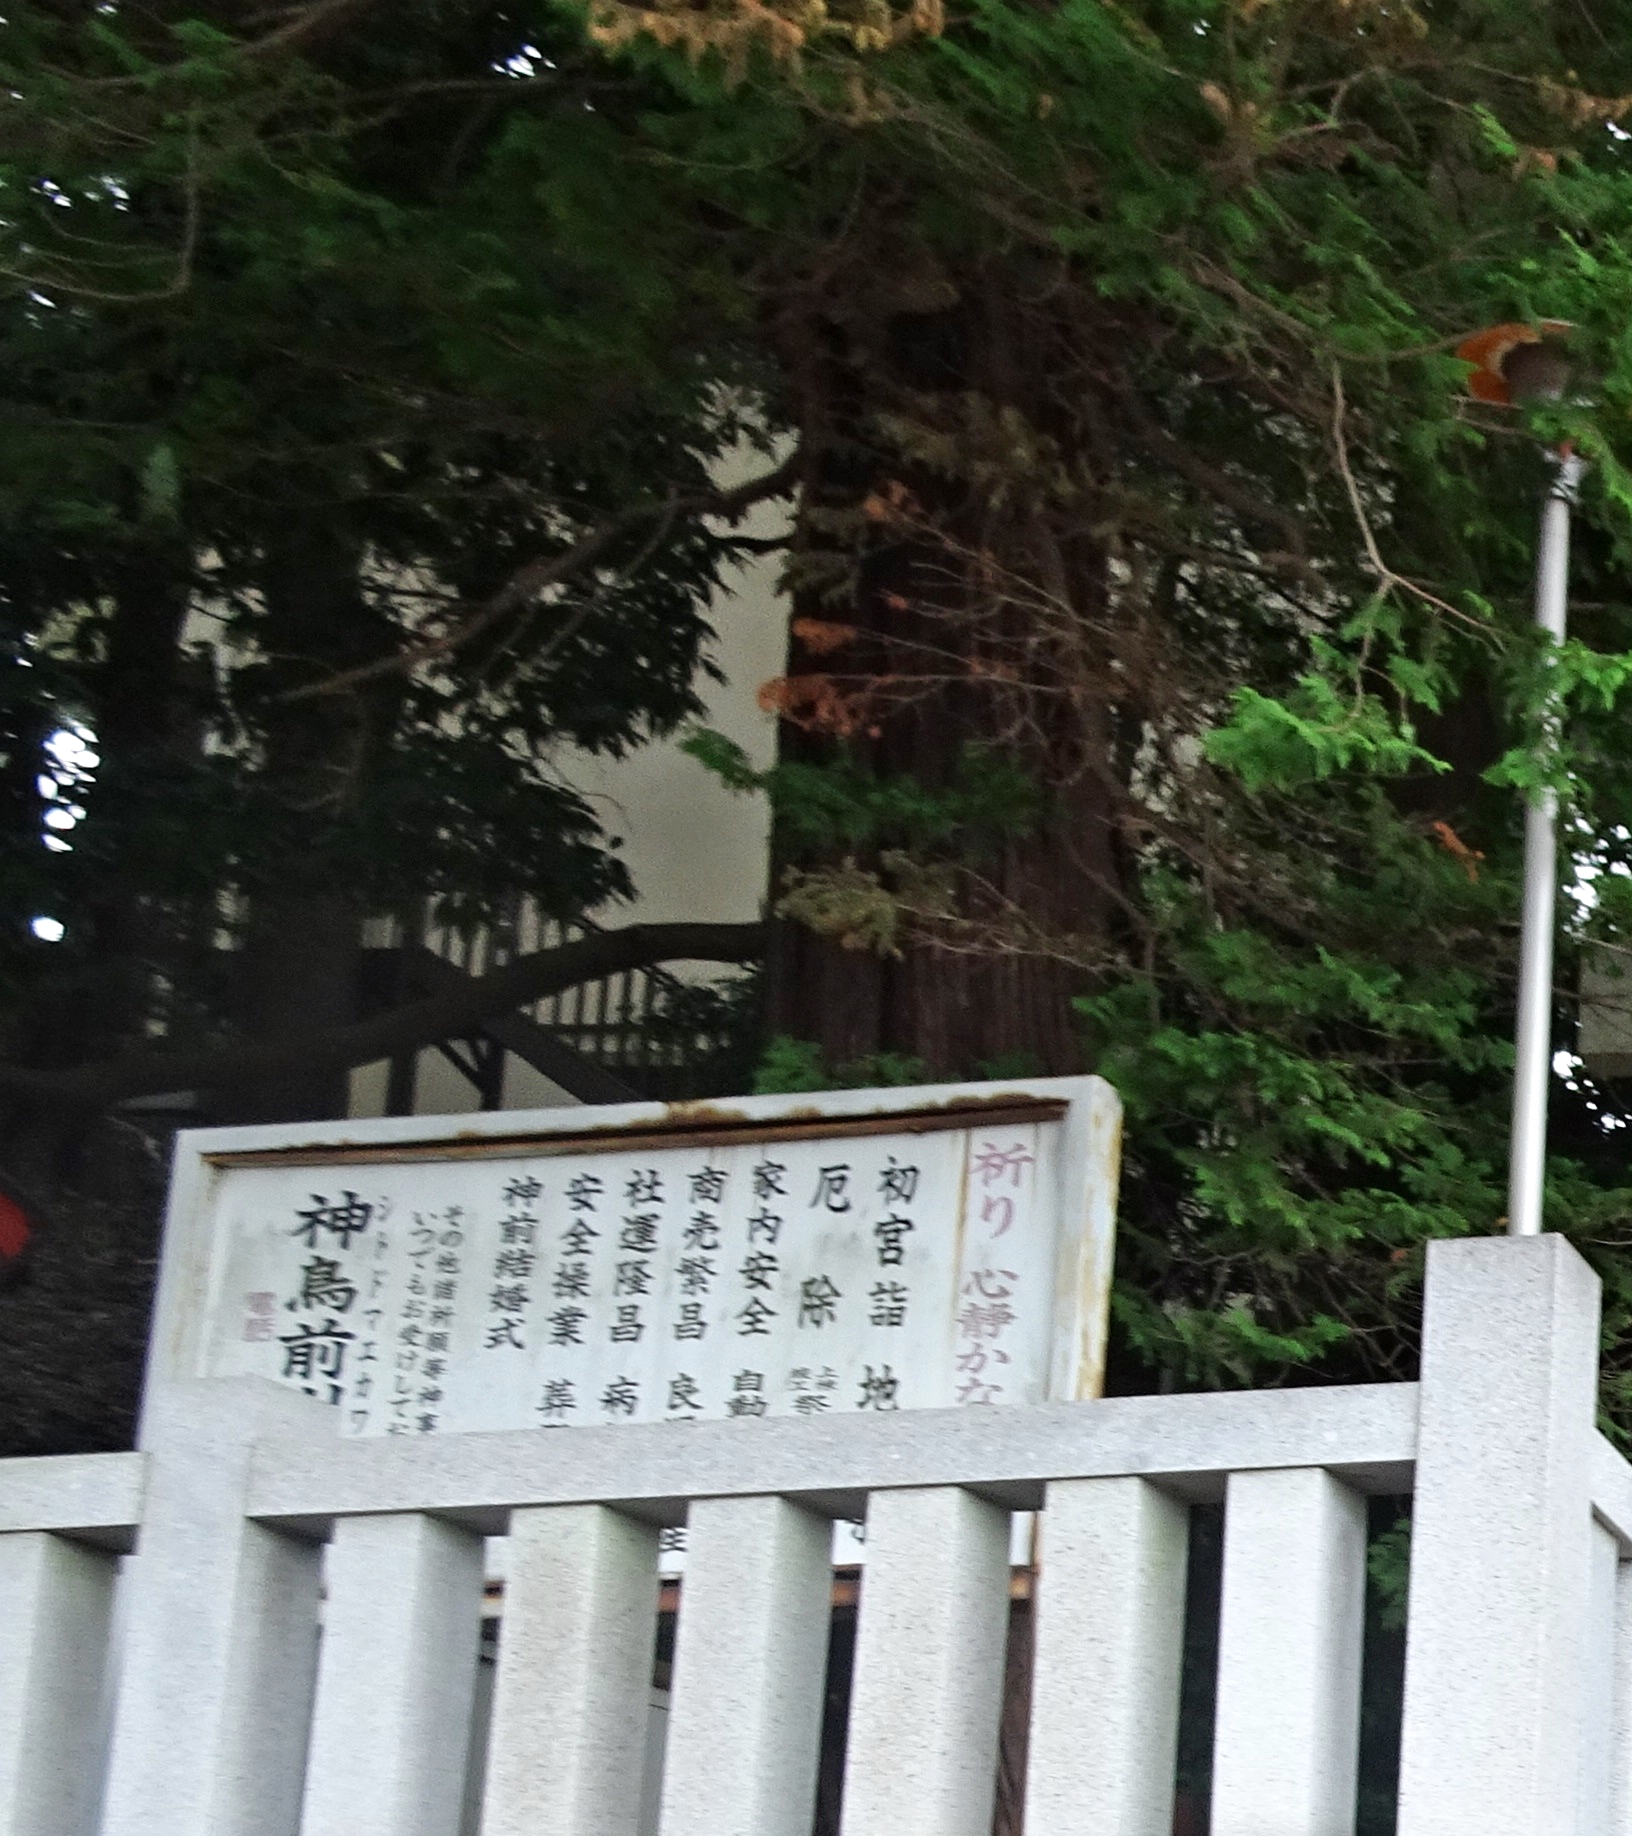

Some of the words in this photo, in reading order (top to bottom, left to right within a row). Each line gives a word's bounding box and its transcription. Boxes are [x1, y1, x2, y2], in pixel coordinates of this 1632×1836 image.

[484, 1176, 544, 1350] 神前結婚式
[546, 1173, 604, 1346] 安全操業
[674, 1166, 729, 1340] 商売繁昌
[737, 1160, 790, 1335] 家内安全
[868, 1154, 919, 1327] 初宮詣
[970, 1142, 1035, 1239] 祈り
